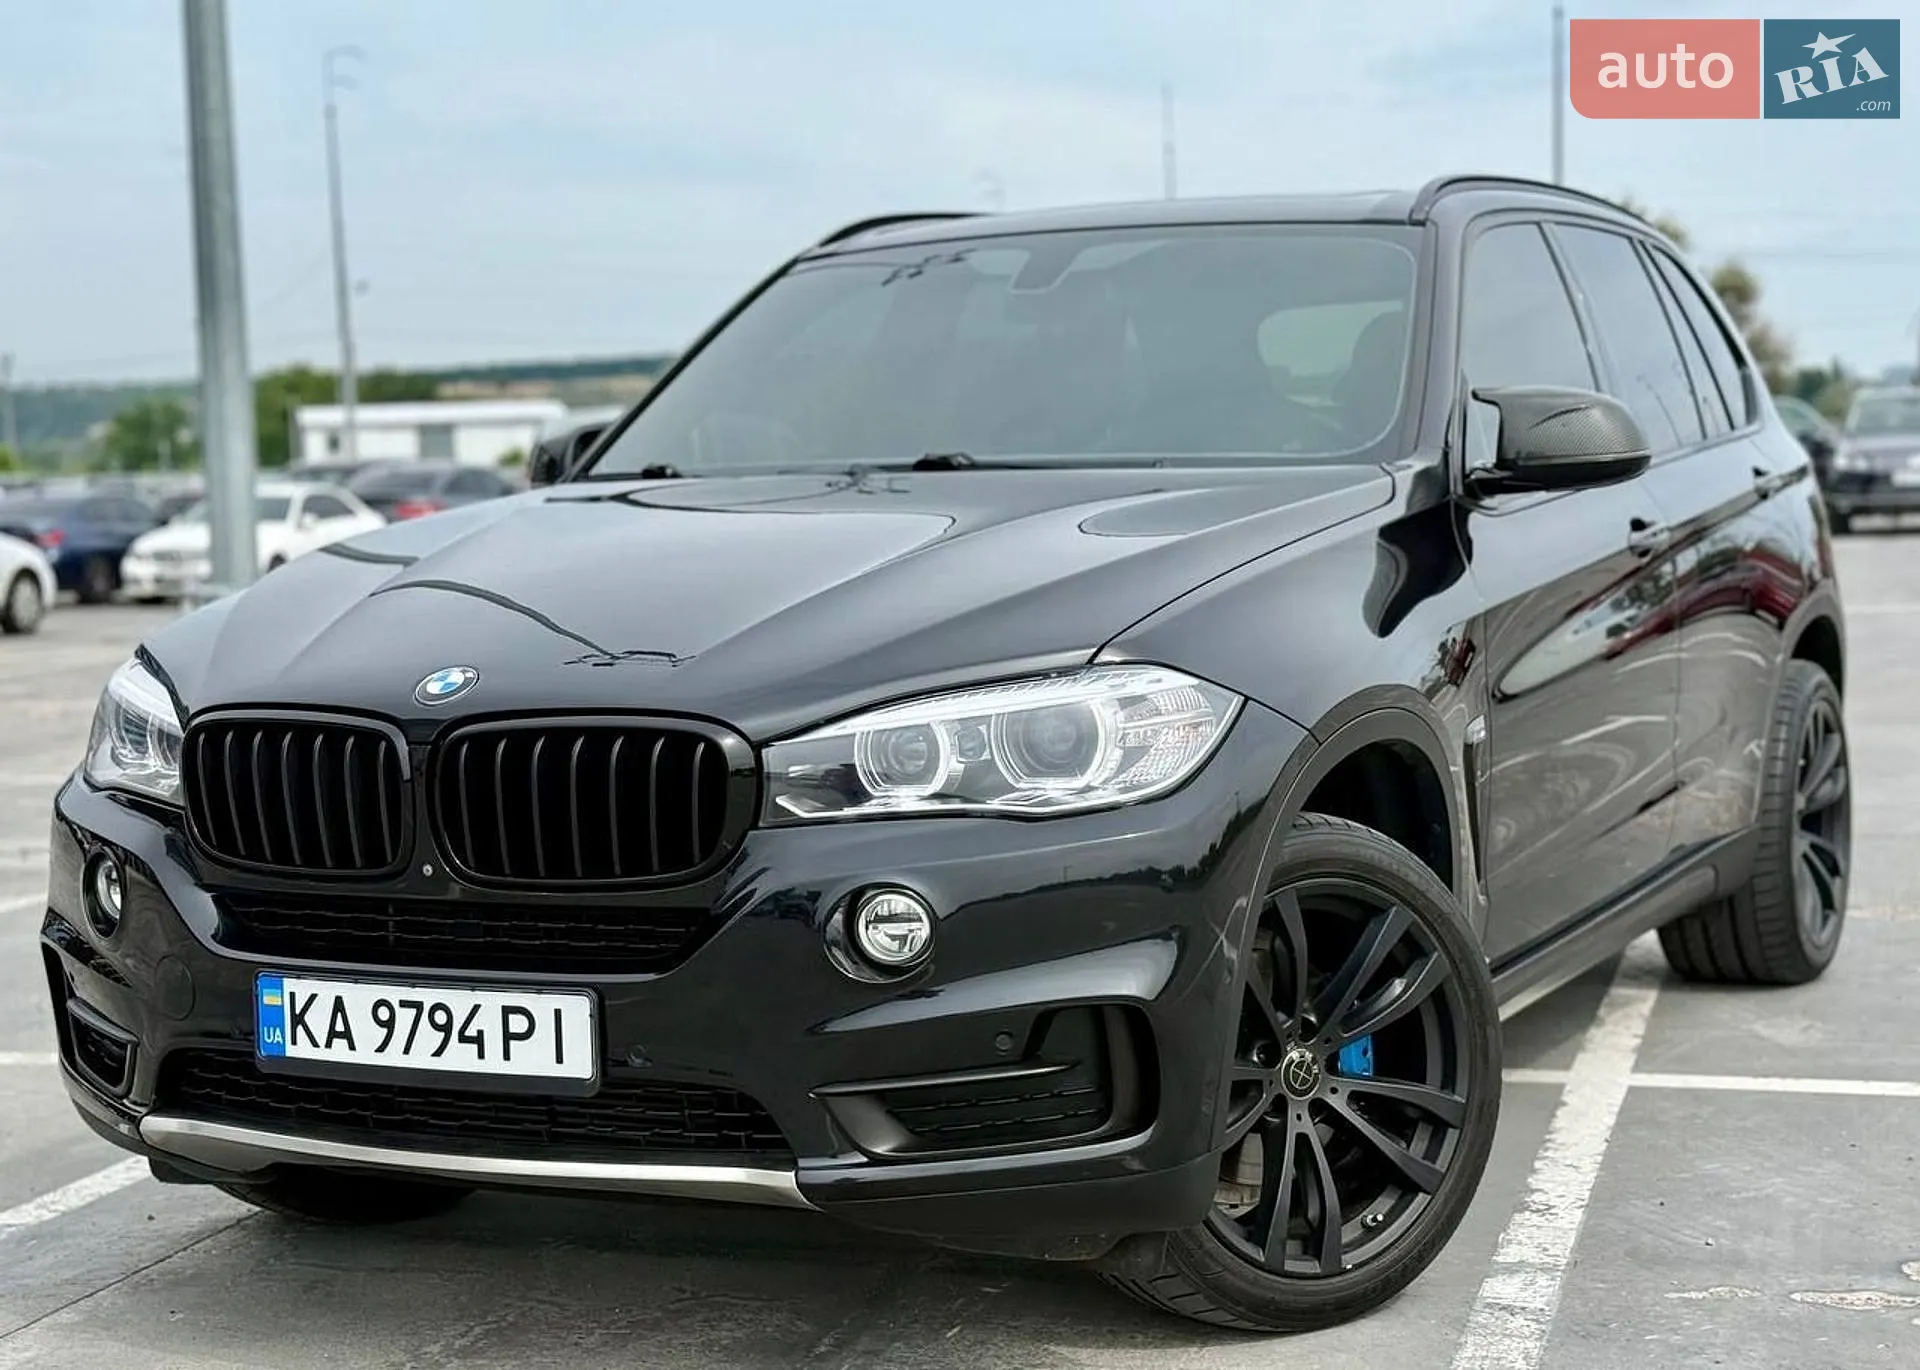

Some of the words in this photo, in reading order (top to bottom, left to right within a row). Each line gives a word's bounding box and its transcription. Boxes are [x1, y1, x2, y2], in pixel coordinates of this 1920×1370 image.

[263, 1026, 284, 1044] UA
[289, 991, 356, 1051] KA
[371, 998, 486, 1060] 9794
